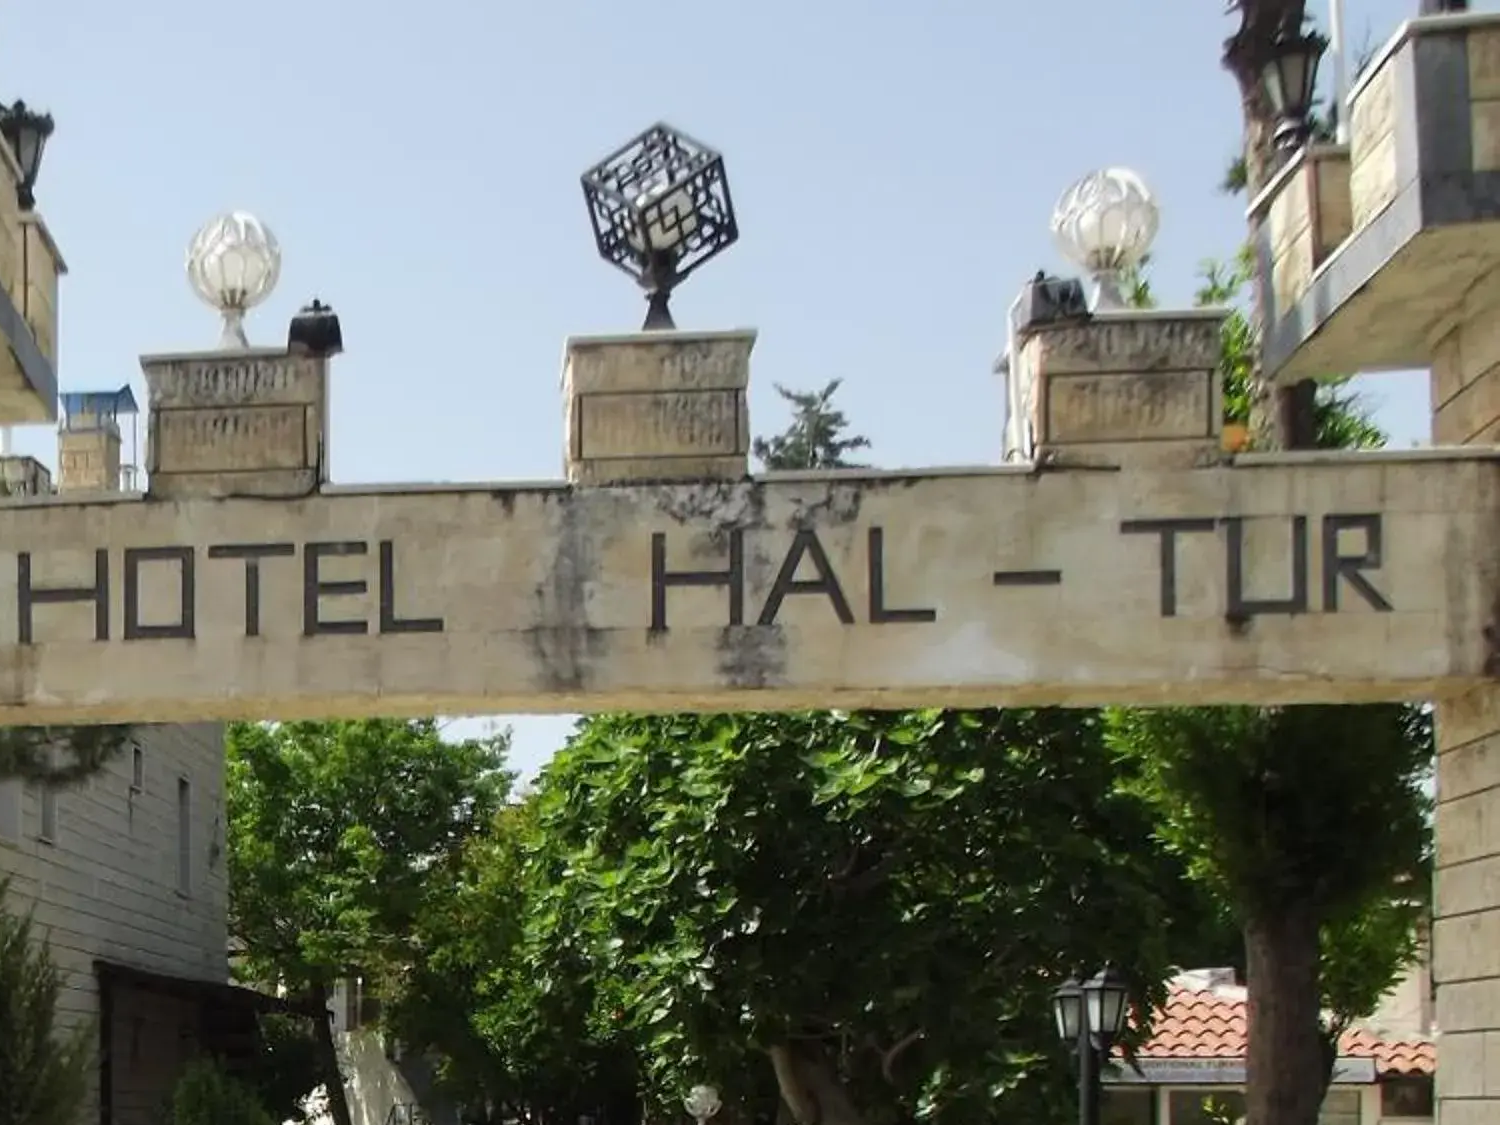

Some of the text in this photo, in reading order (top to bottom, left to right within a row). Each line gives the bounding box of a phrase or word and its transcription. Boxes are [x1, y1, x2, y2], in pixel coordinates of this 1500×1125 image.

[18, 539, 444, 645] HOTEL
[650, 526, 937, 631] HAL
[1120, 513, 1394, 618] TUR
